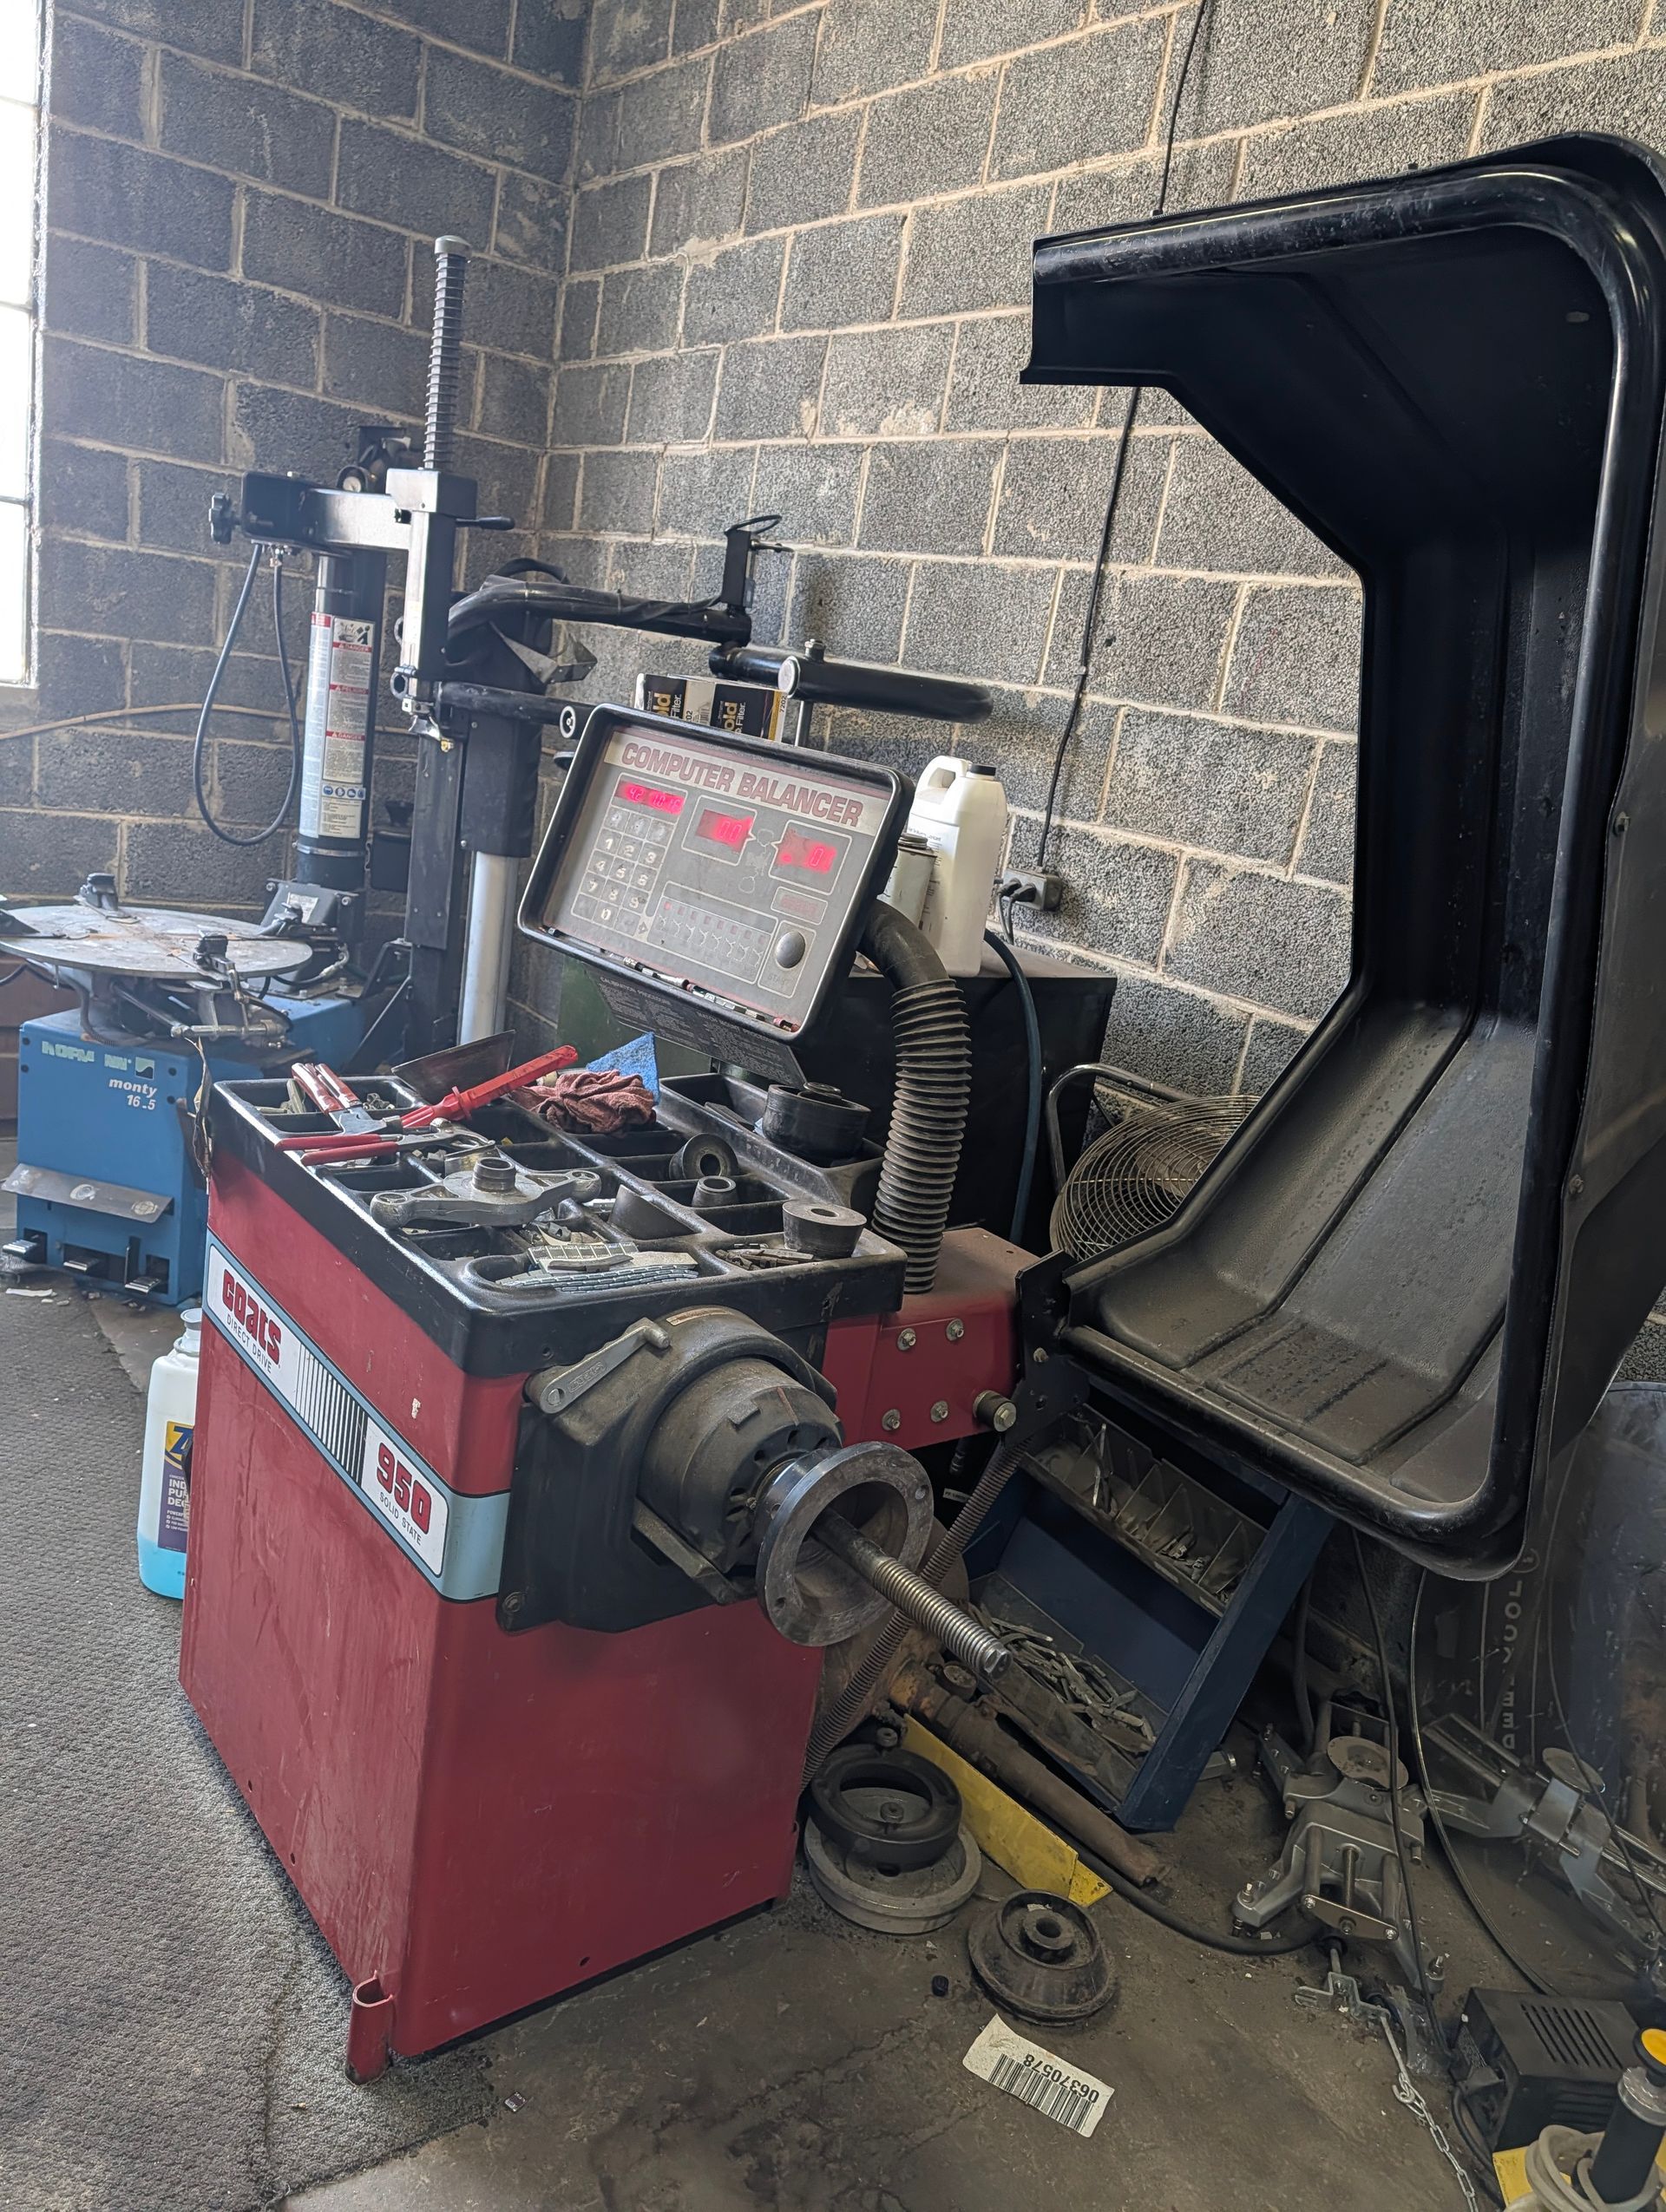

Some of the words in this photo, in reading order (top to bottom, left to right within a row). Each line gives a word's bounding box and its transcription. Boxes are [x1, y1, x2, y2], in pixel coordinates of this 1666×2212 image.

[620, 742, 736, 793] COMPUTER
[738, 773, 863, 828] BALANCER
[605, 838, 613, 850] 1
[646, 851, 657, 864] 3
[638, 874, 648, 886] 6
[600, 908, 611, 920] 0
[109, 1078, 158, 1097] monty
[226, 1314, 252, 1349] DIRECT
[252, 1344, 272, 1374] DRIVE
[376, 1442, 432, 1535] 950
[379, 1491, 399, 1519] SOLID
[402, 1516, 422, 1546] STATE
[1024, 2055, 1099, 2104] 06370578
